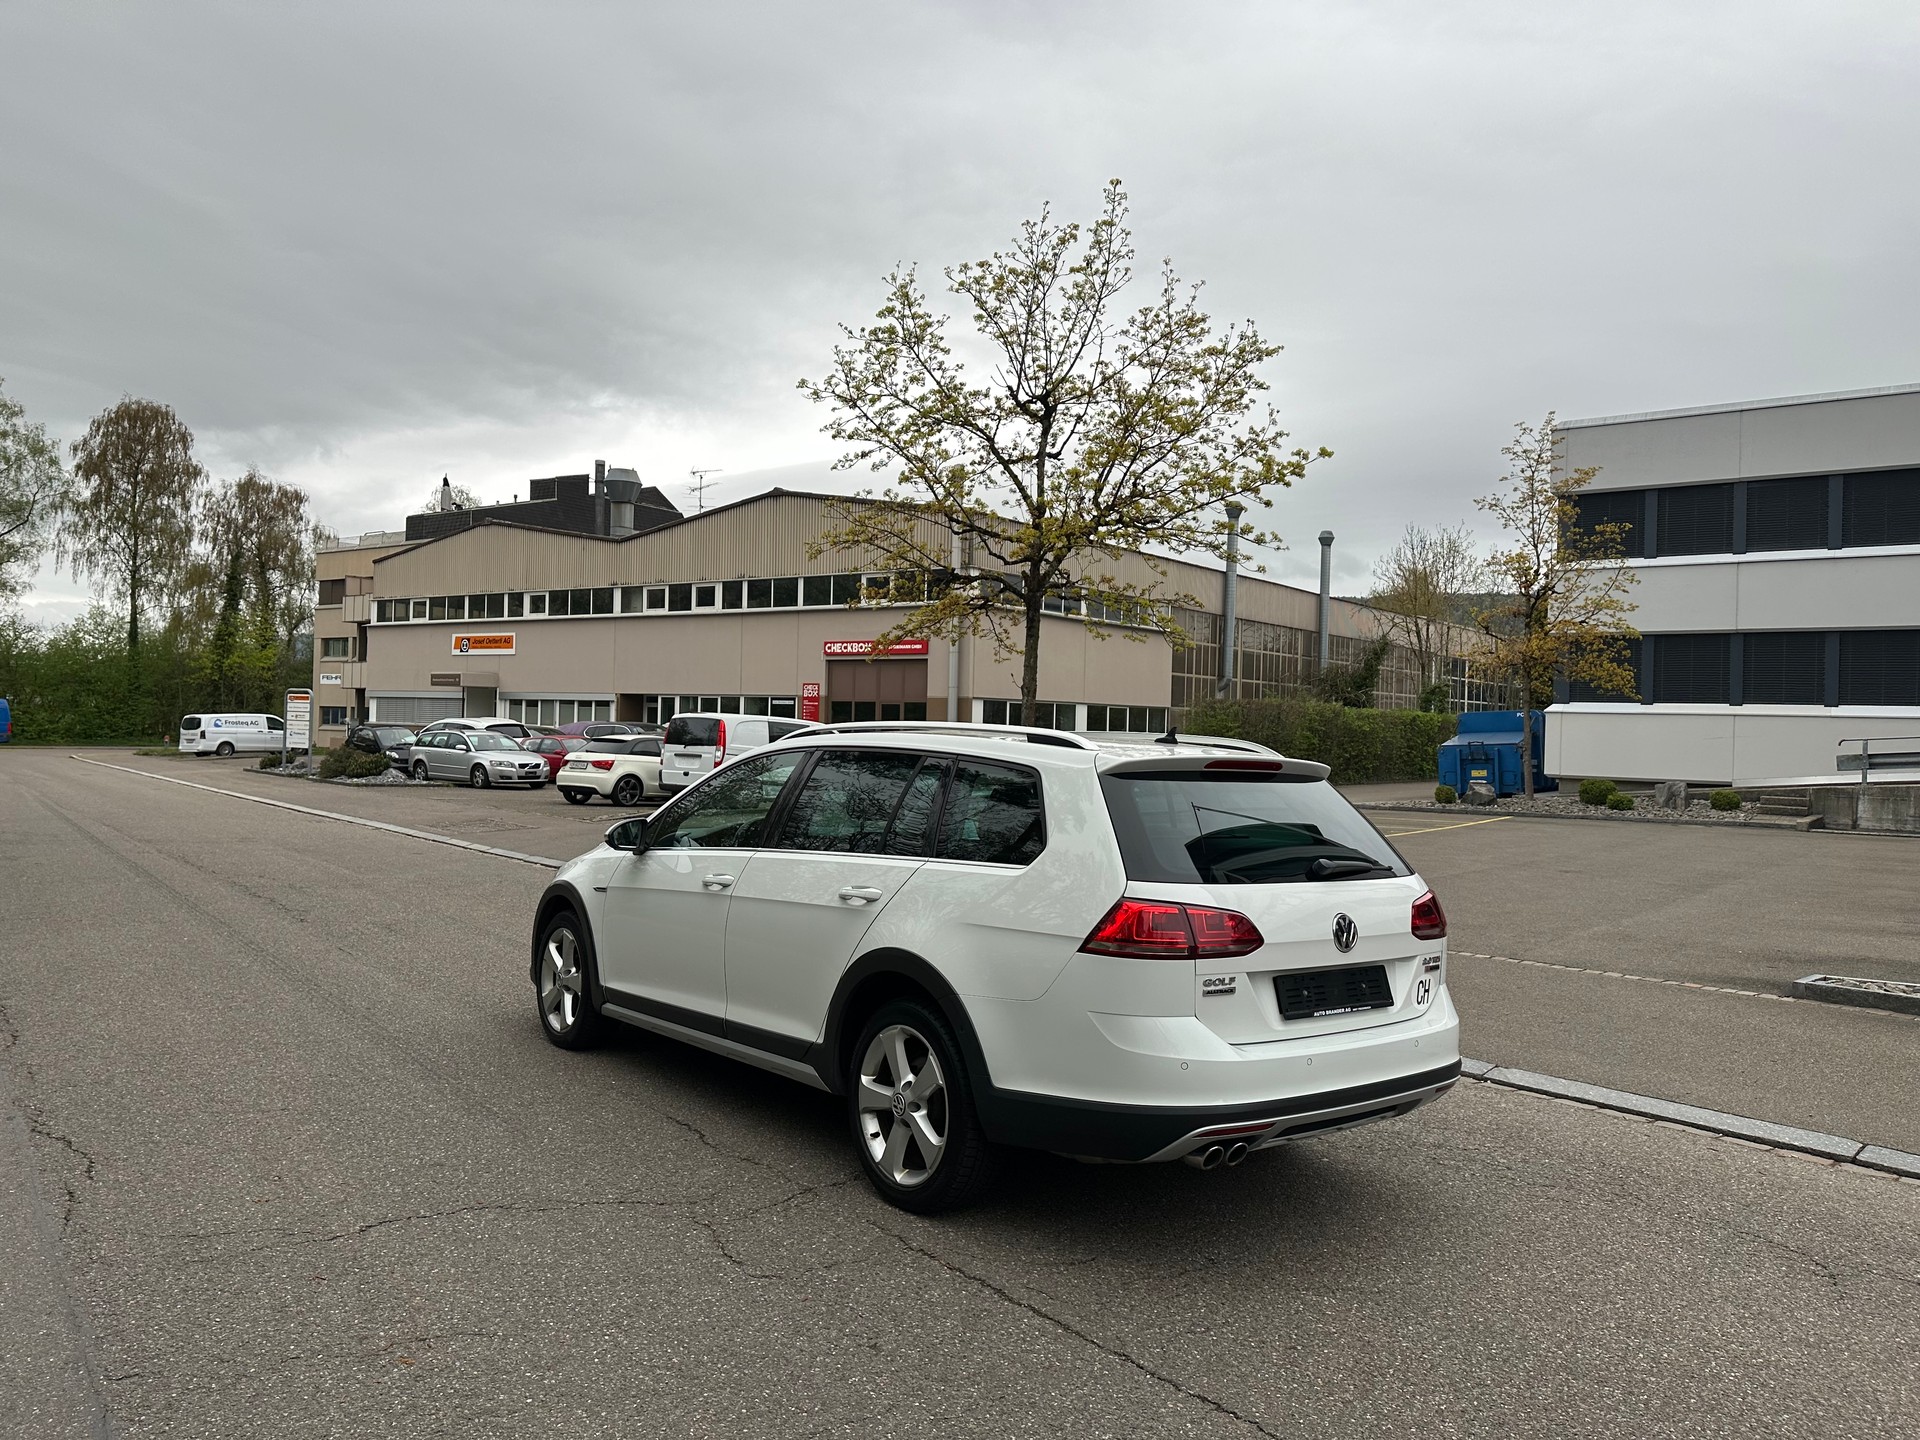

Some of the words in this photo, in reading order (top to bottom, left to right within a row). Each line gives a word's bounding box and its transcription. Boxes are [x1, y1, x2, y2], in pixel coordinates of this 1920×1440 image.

[472, 637, 486, 645] Josef
[825, 642, 872, 653] CHECKBOX
[1202, 976, 1236, 987] GOLF
[1416, 978, 1431, 1006] CH
